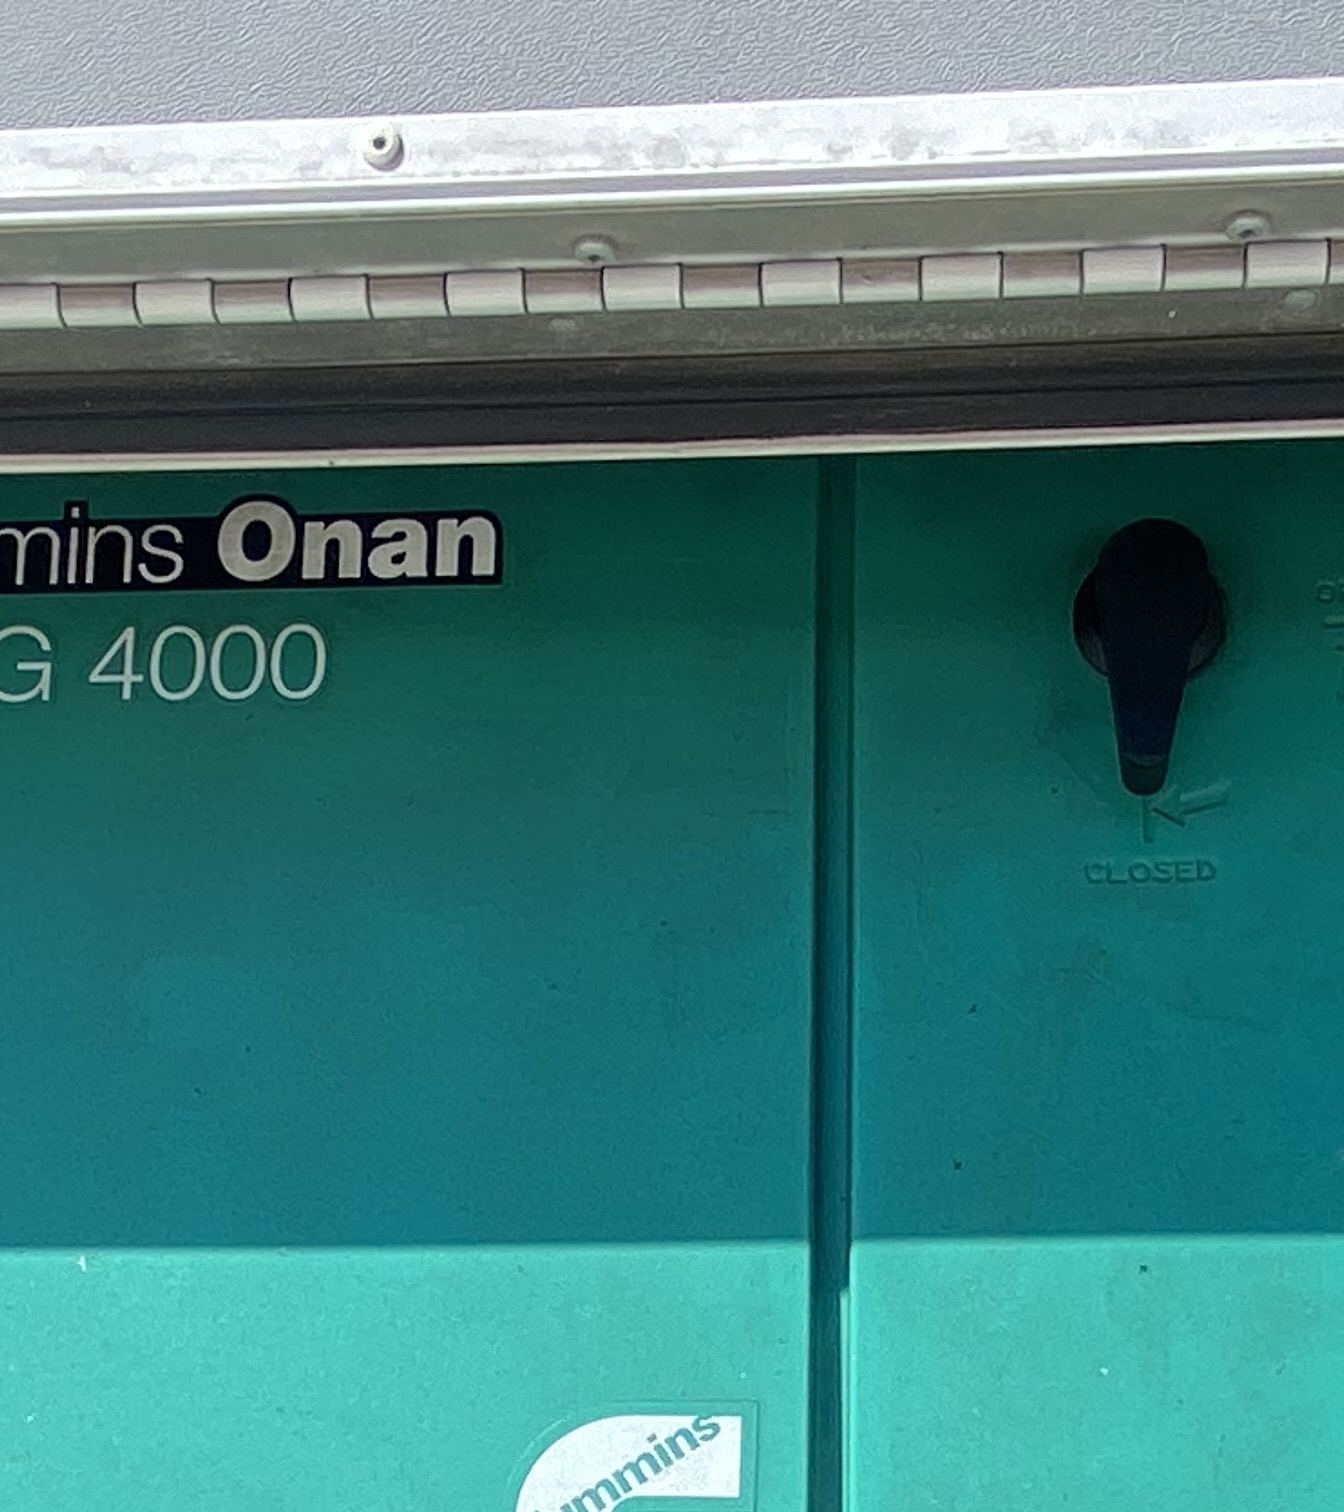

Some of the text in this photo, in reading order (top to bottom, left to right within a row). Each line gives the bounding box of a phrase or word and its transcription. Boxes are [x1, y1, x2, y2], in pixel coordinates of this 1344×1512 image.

[216, 498, 498, 583] Onan
[89, 623, 327, 702] 4000
[1083, 859, 1217, 884] CLOSED
